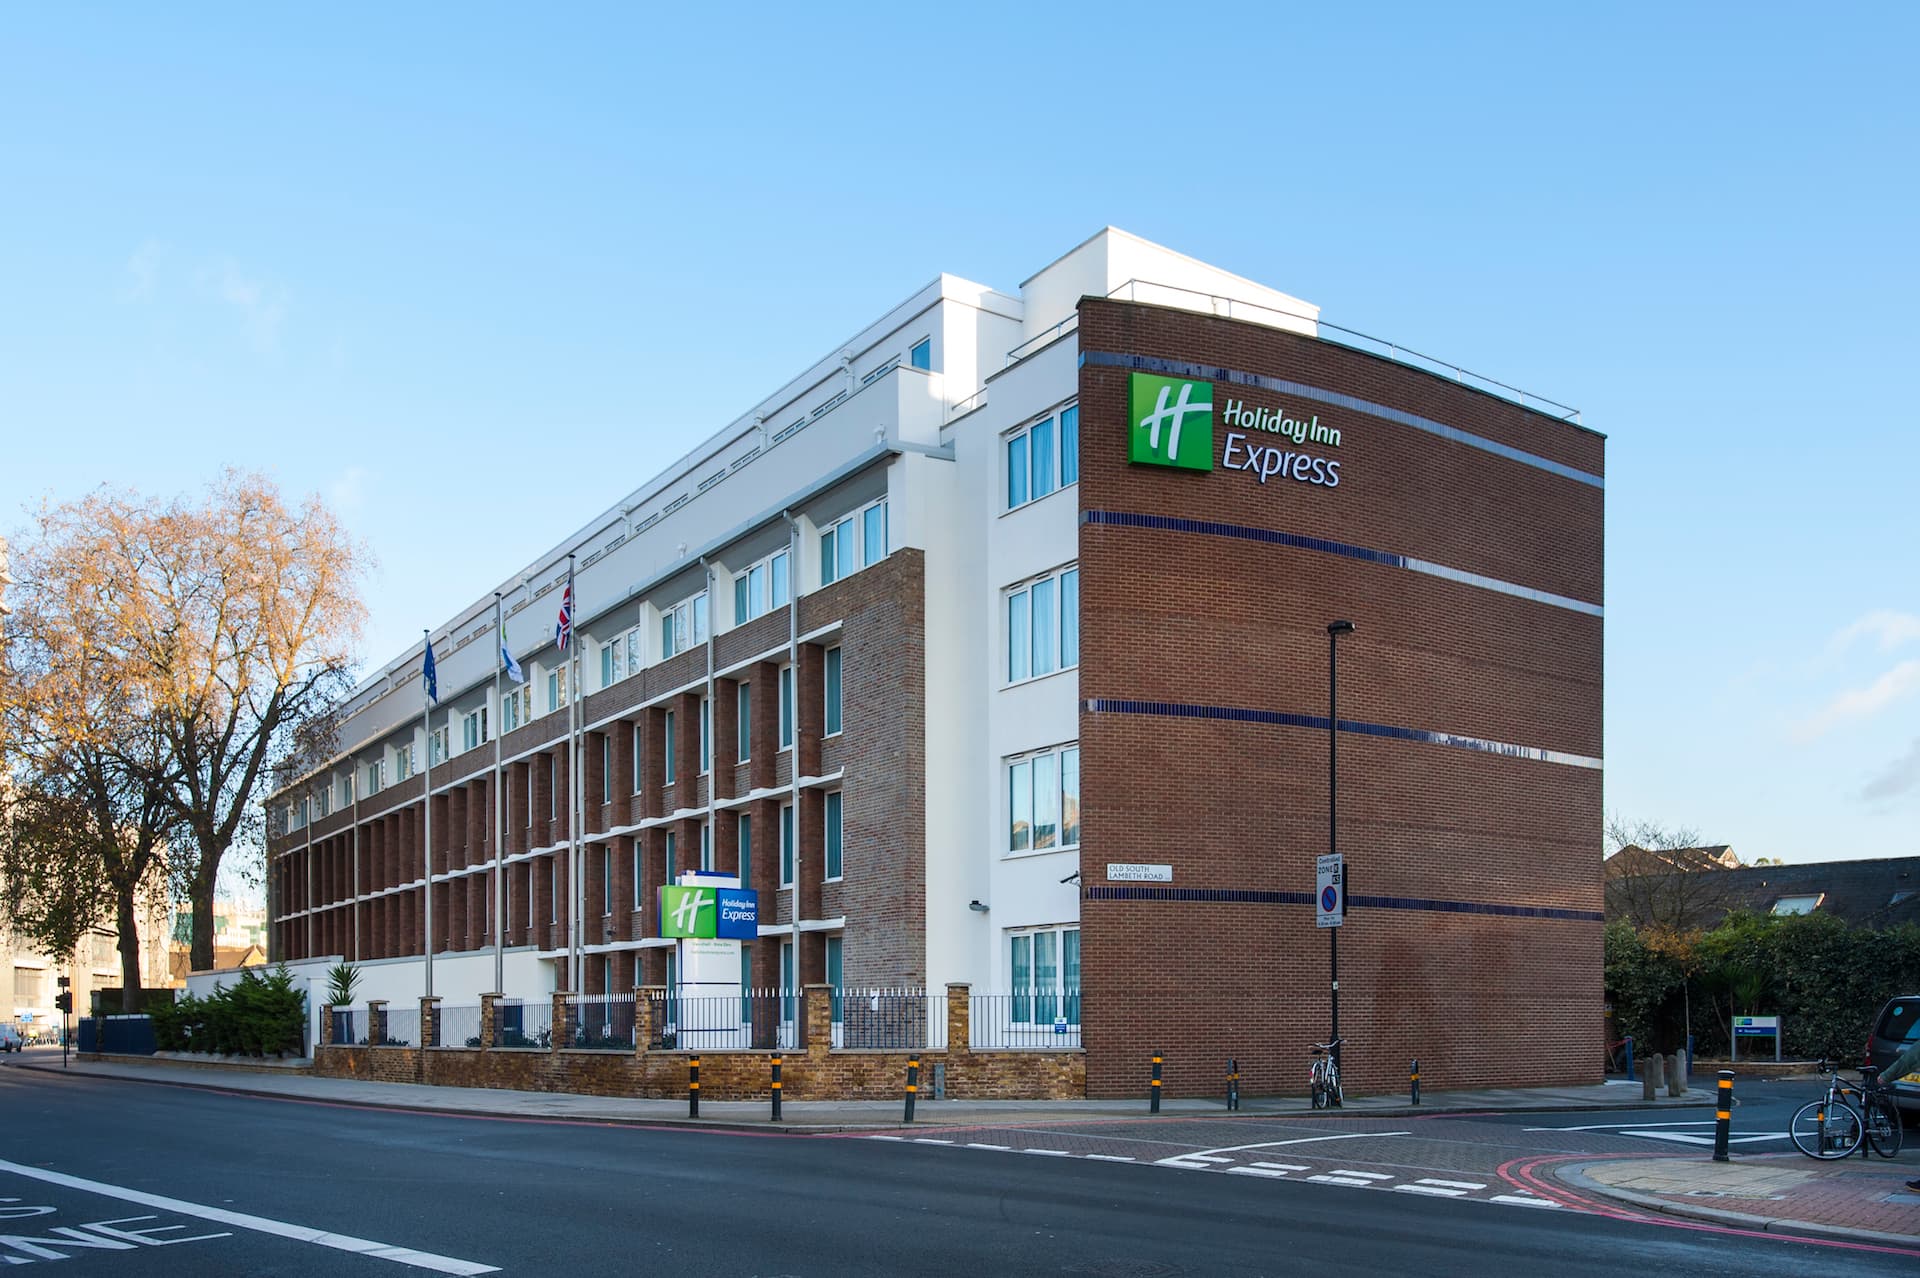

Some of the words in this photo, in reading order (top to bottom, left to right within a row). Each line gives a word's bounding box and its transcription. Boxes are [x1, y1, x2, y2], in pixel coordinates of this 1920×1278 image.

[1222, 398, 1308, 445] Holiday
[1310, 415, 1342, 447] Inn
[1222, 432, 1341, 488] Express
[1125, 865, 1150, 873] SOUTH
[722, 898, 745, 909] Holiday
[745, 900, 755, 908] Inn
[722, 908, 755, 922] Express
